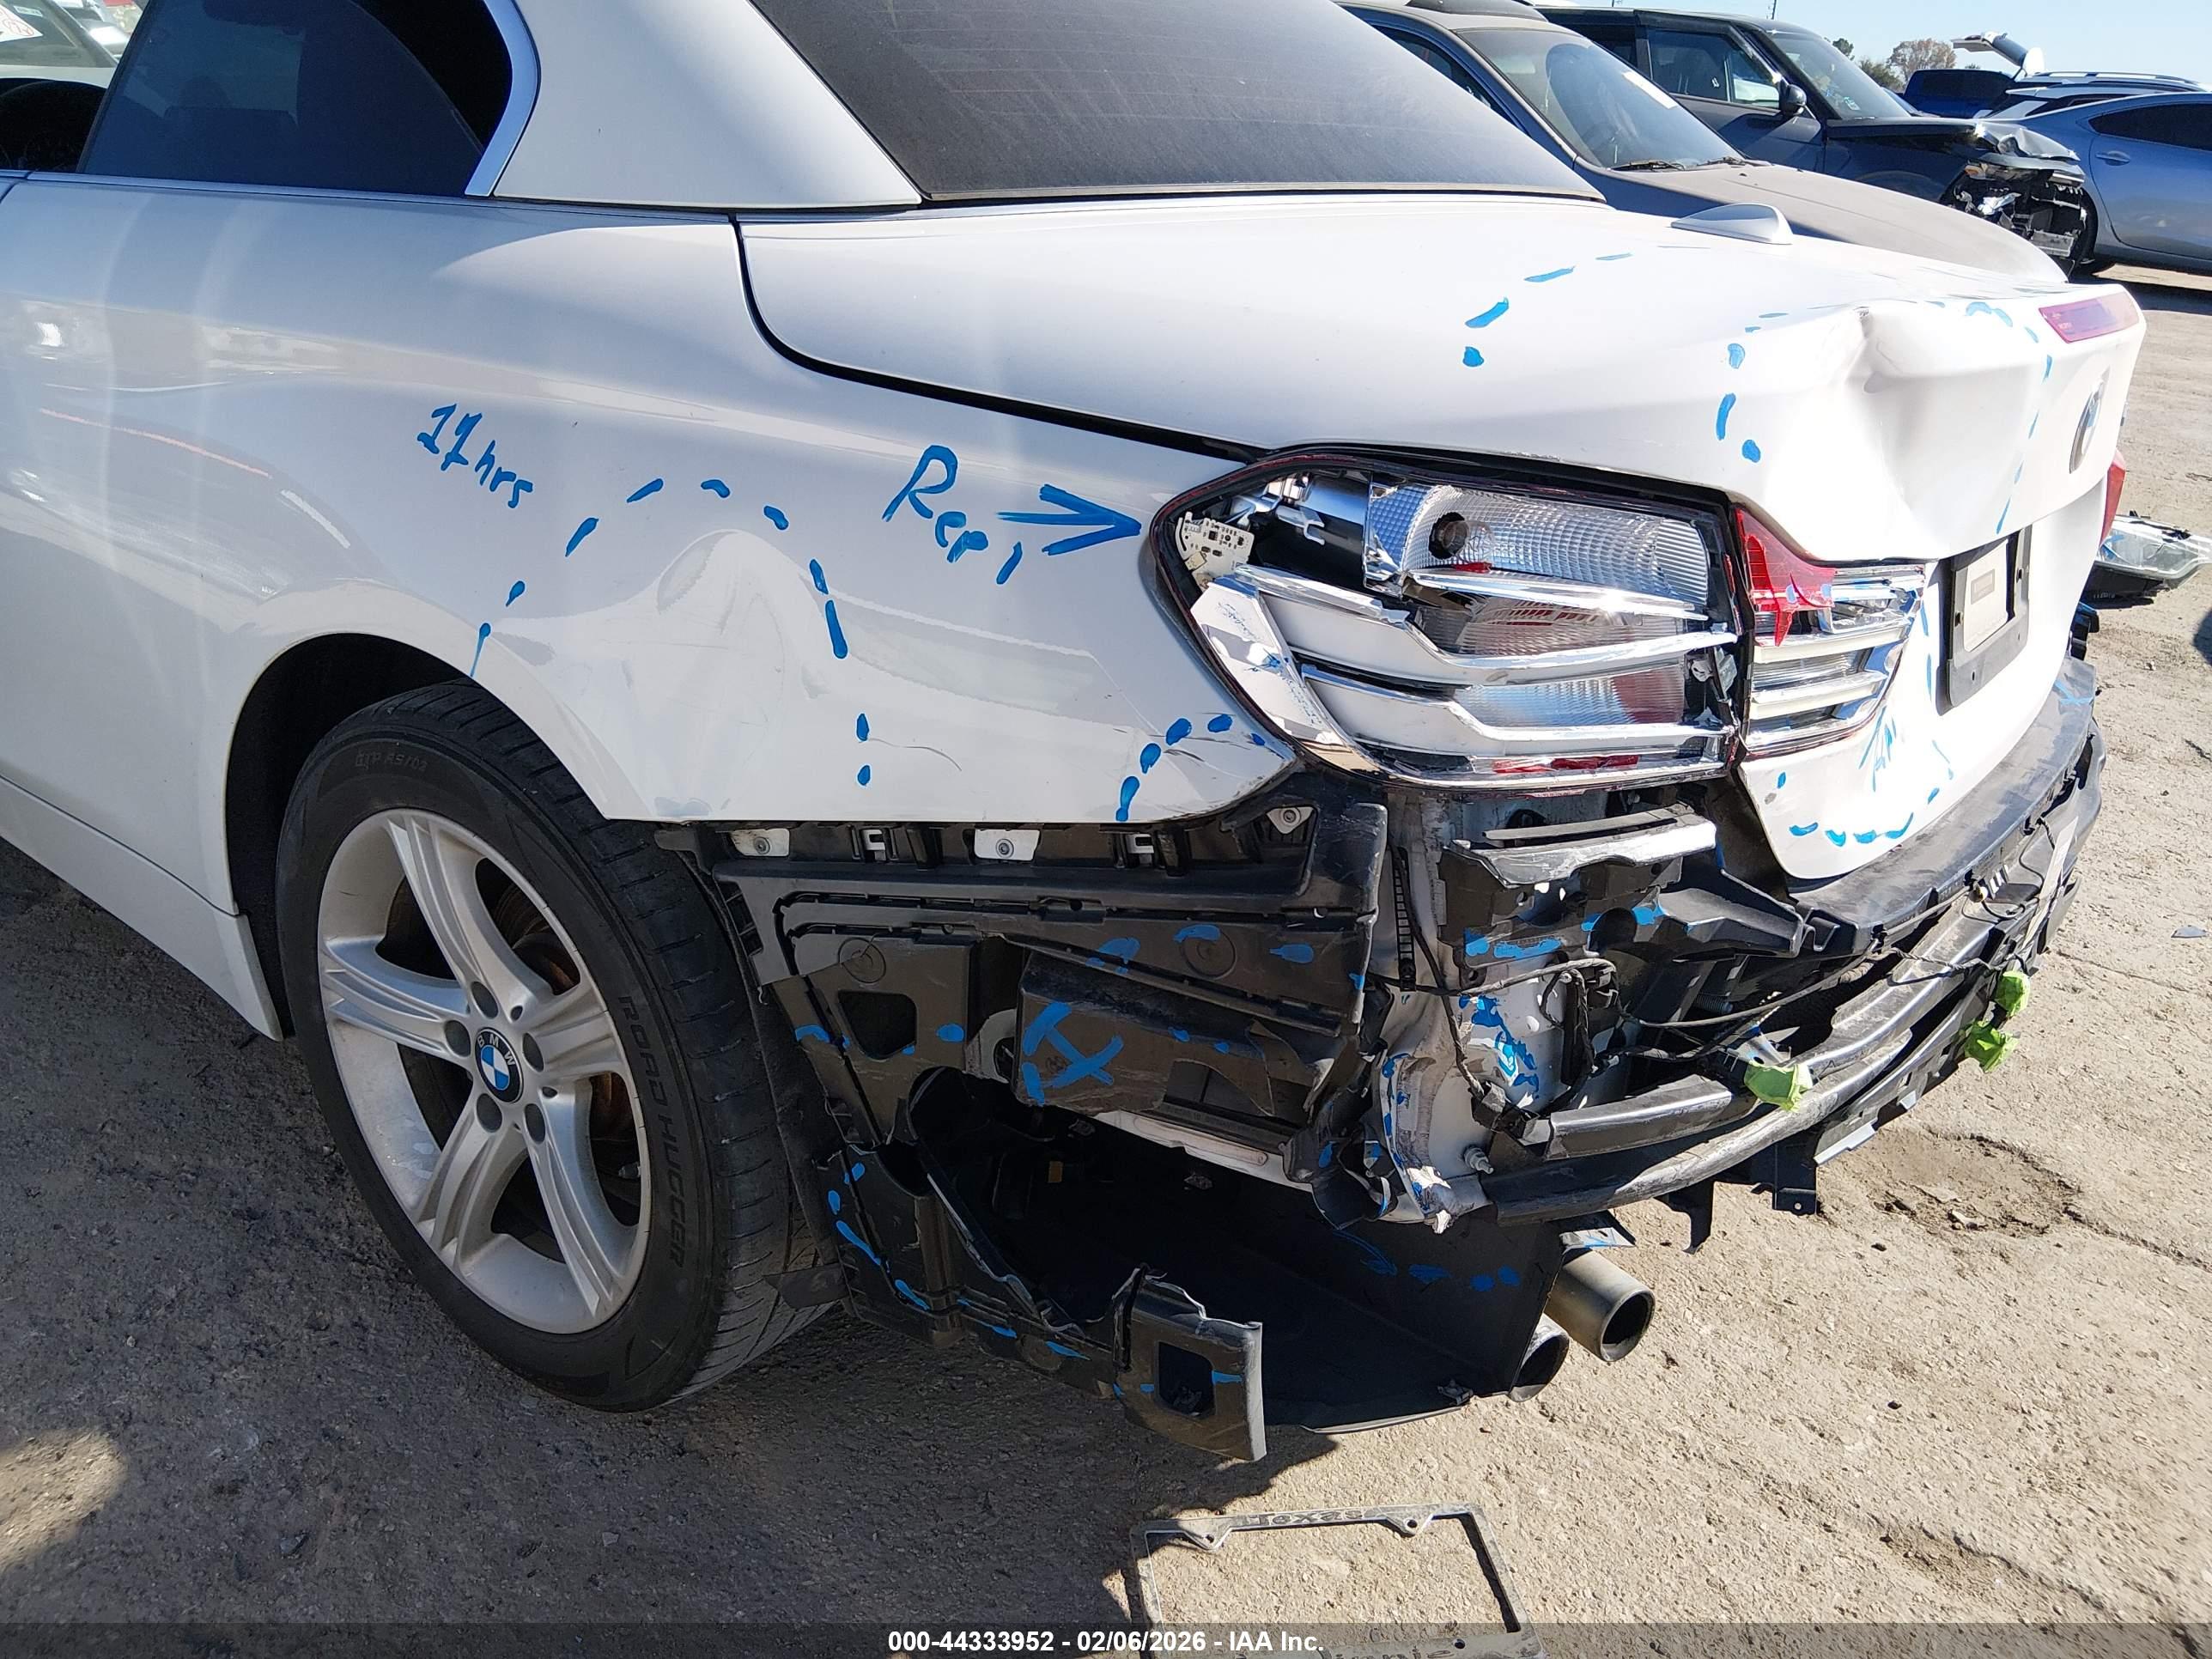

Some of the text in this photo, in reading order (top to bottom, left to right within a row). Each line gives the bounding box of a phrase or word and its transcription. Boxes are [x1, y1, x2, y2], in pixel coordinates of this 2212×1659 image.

[477, 1034, 516, 1066] BMW
[617, 995, 687, 1268] ROAD HUGGER
[1249, 1510, 1363, 1526] Texas
